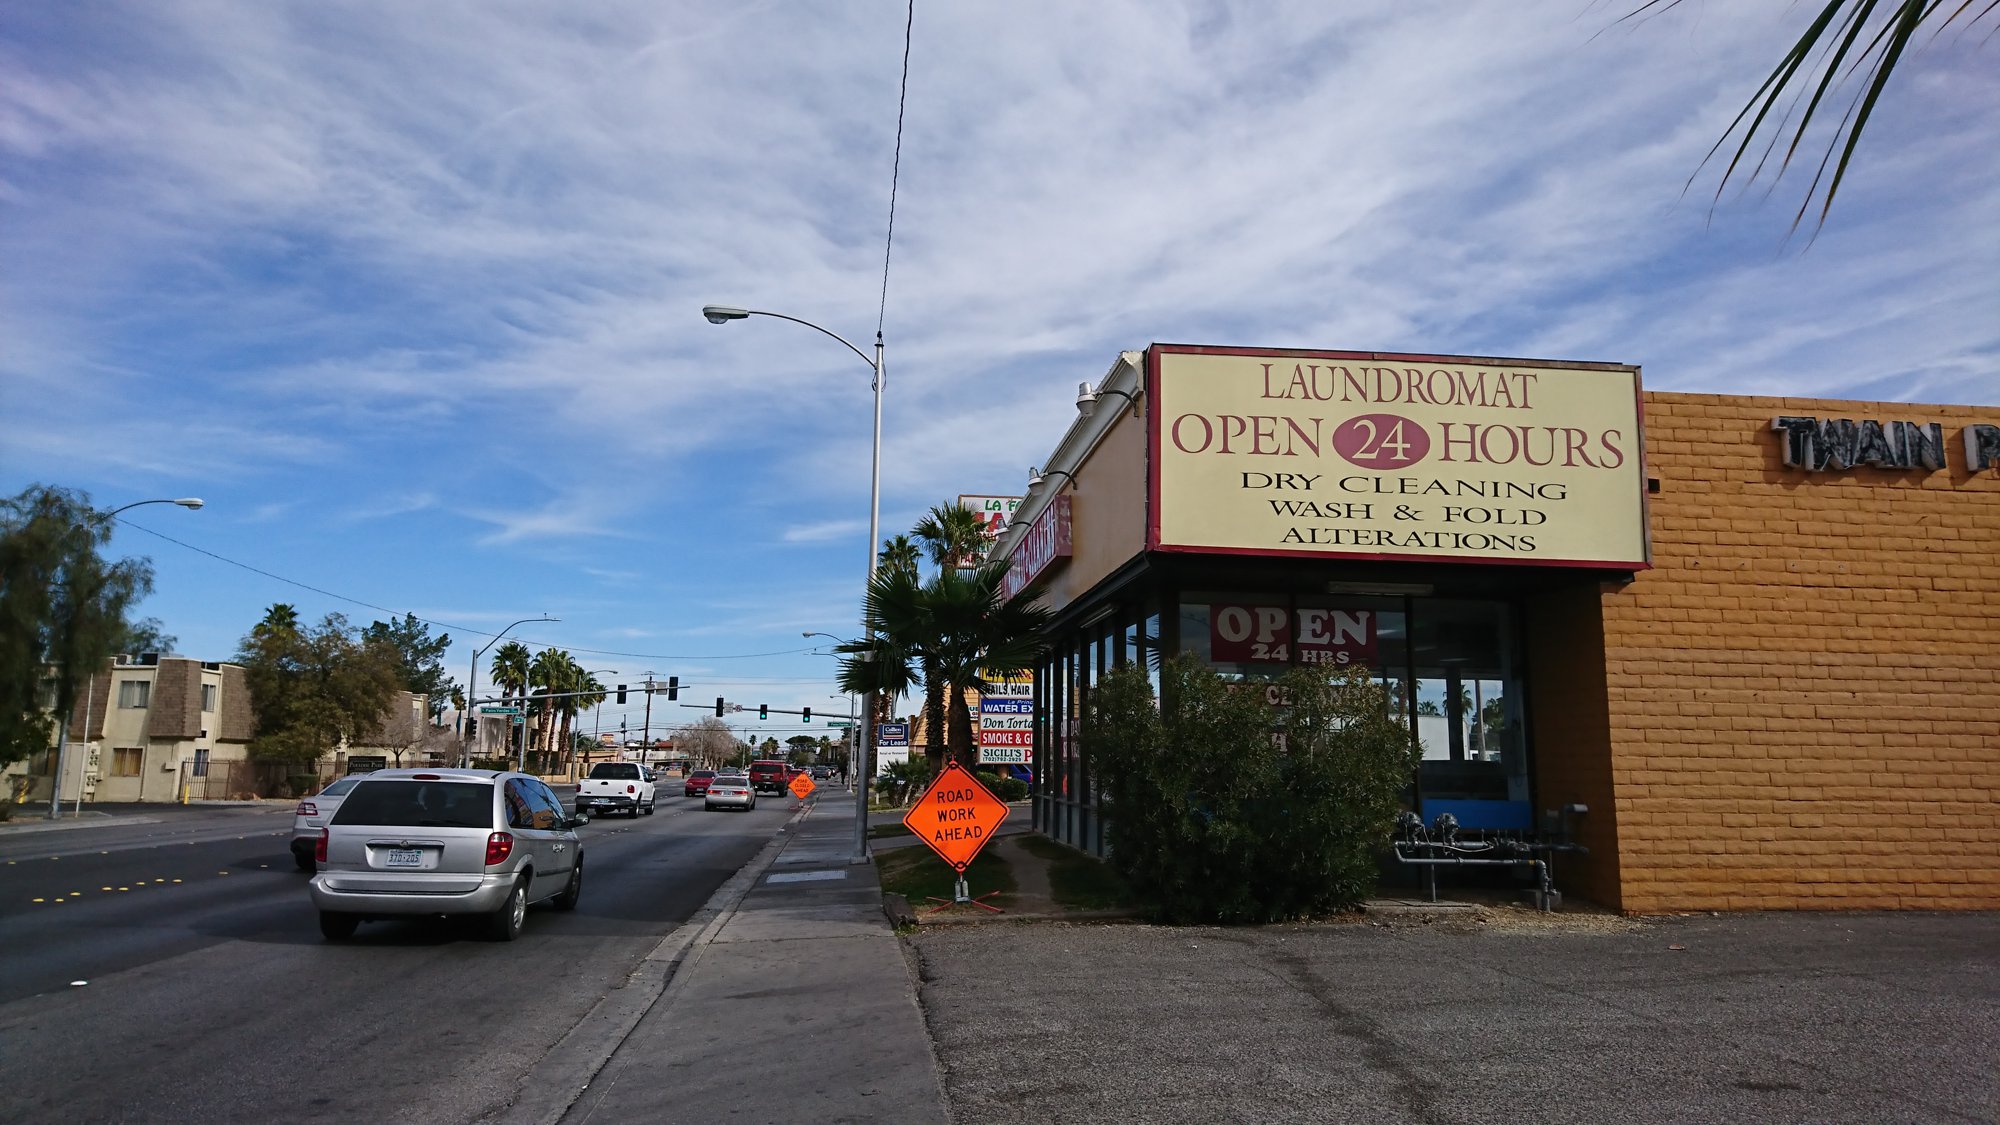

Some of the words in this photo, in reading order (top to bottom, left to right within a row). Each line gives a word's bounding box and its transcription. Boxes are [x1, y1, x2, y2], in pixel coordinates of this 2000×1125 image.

[1260, 362, 1538, 409] LAUNDROMAT
[1171, 413, 1320, 458] OPEN
[1352, 419, 1412, 461] 24
[1437, 422, 1624, 470] HOURS
[1770, 416, 1947, 472] TWAIN
[1241, 472, 1323, 491] DRY
[1338, 475, 1568, 501] CLEANING
[985, 499, 1001, 511] LA
[1268, 499, 1374, 521] WASH
[1393, 503, 1425, 522] &
[1444, 506, 1547, 526] FOLD
[1280, 527, 1537, 553] ALTERATIONS
[1216, 606, 1371, 646] OPEN
[1250, 643, 1289, 662] 24
[1301, 649, 1350, 665] HRS
[1011, 685, 1030, 695] HAIR
[984, 704, 1018, 713] WATER
[983, 717, 1005, 729] Don
[983, 732, 1013, 744] SMOKE
[1015, 733, 1022, 744] &
[983, 749, 1022, 757] SICILI'S
[937, 788, 974, 804] ROAD
[937, 807, 977, 823] WORK
[934, 825, 983, 842] AHEAD
